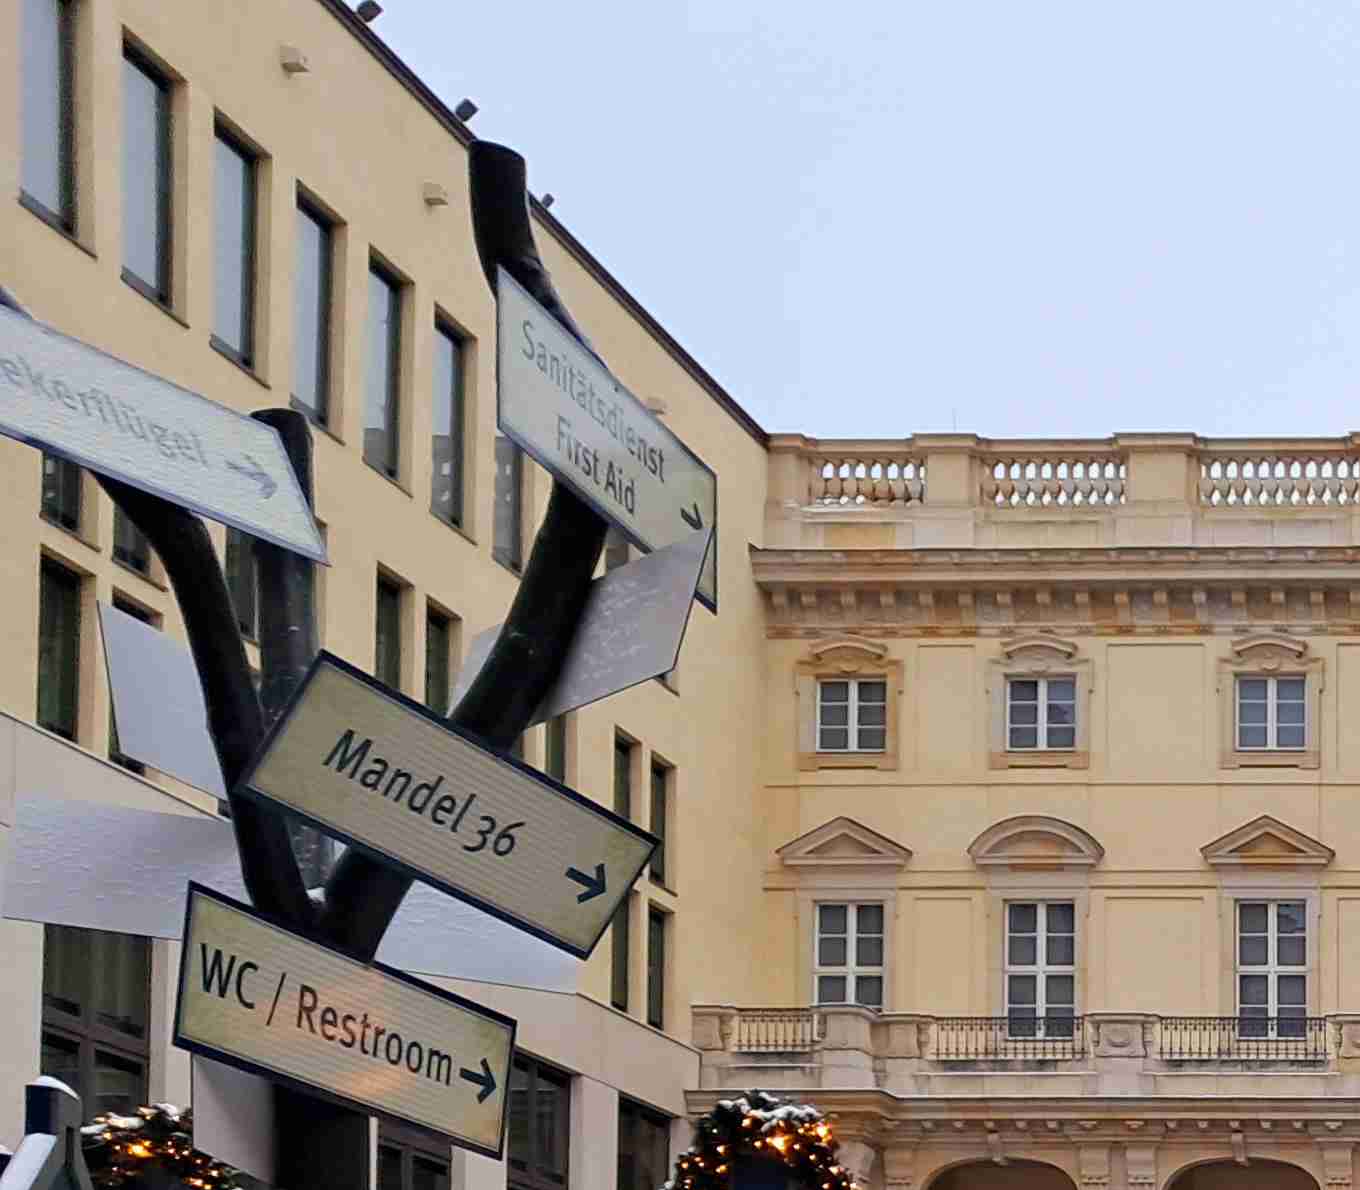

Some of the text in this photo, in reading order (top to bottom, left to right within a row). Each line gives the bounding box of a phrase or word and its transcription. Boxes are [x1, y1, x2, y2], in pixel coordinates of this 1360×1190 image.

[521, 320, 665, 484] Sanitätsdienst
[557, 414, 635, 516] First Aid
[322, 729, 526, 857] Mandel 36
[200, 943, 452, 1087] WC / Restroom
